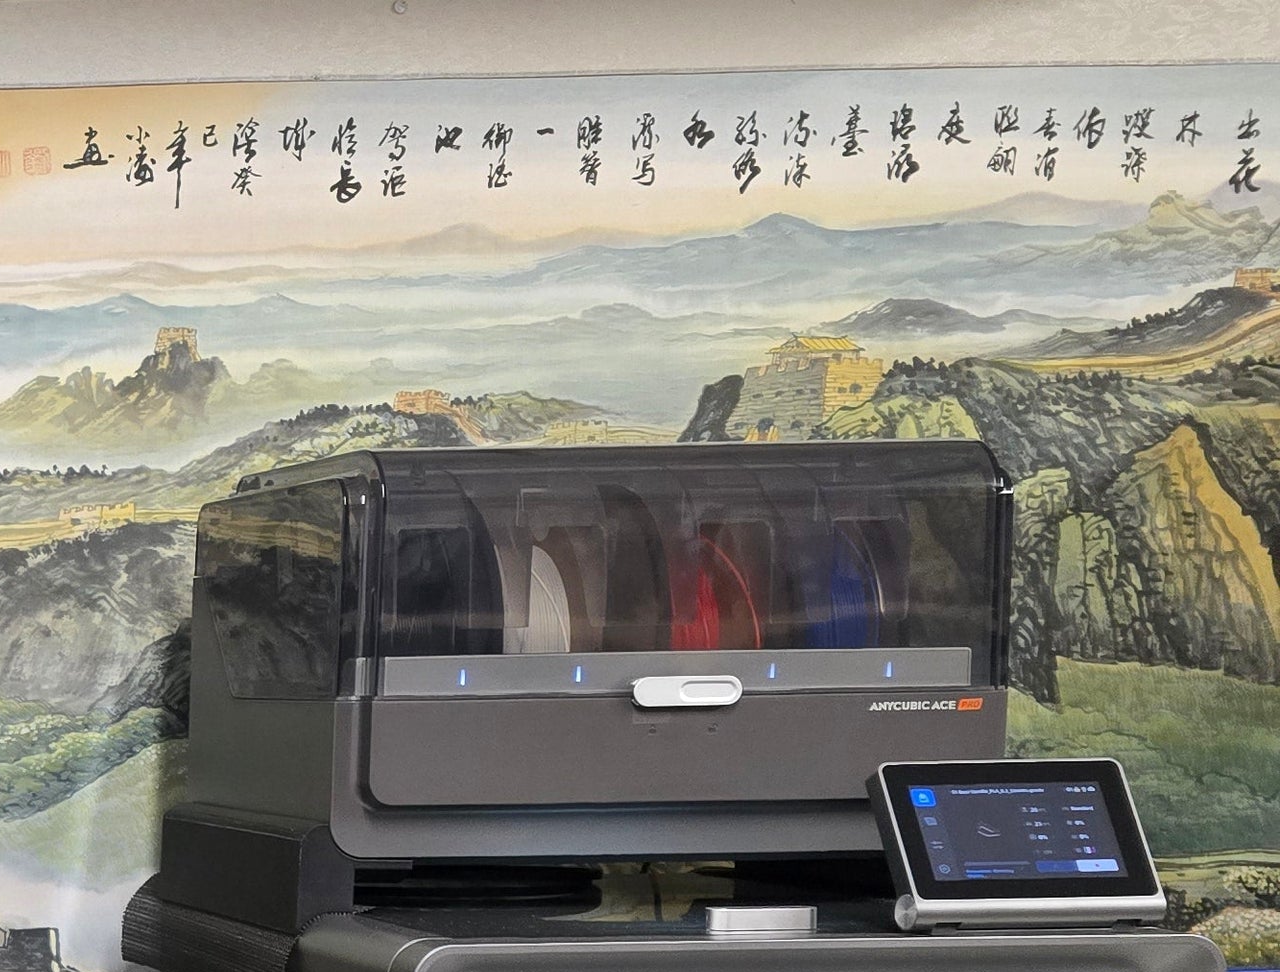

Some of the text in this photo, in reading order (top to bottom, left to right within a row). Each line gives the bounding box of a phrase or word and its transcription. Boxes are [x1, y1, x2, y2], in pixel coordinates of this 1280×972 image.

[536, 126, 555, 136] 一
[868, 700, 981, 711] ANYCUBIC ACE PRO
